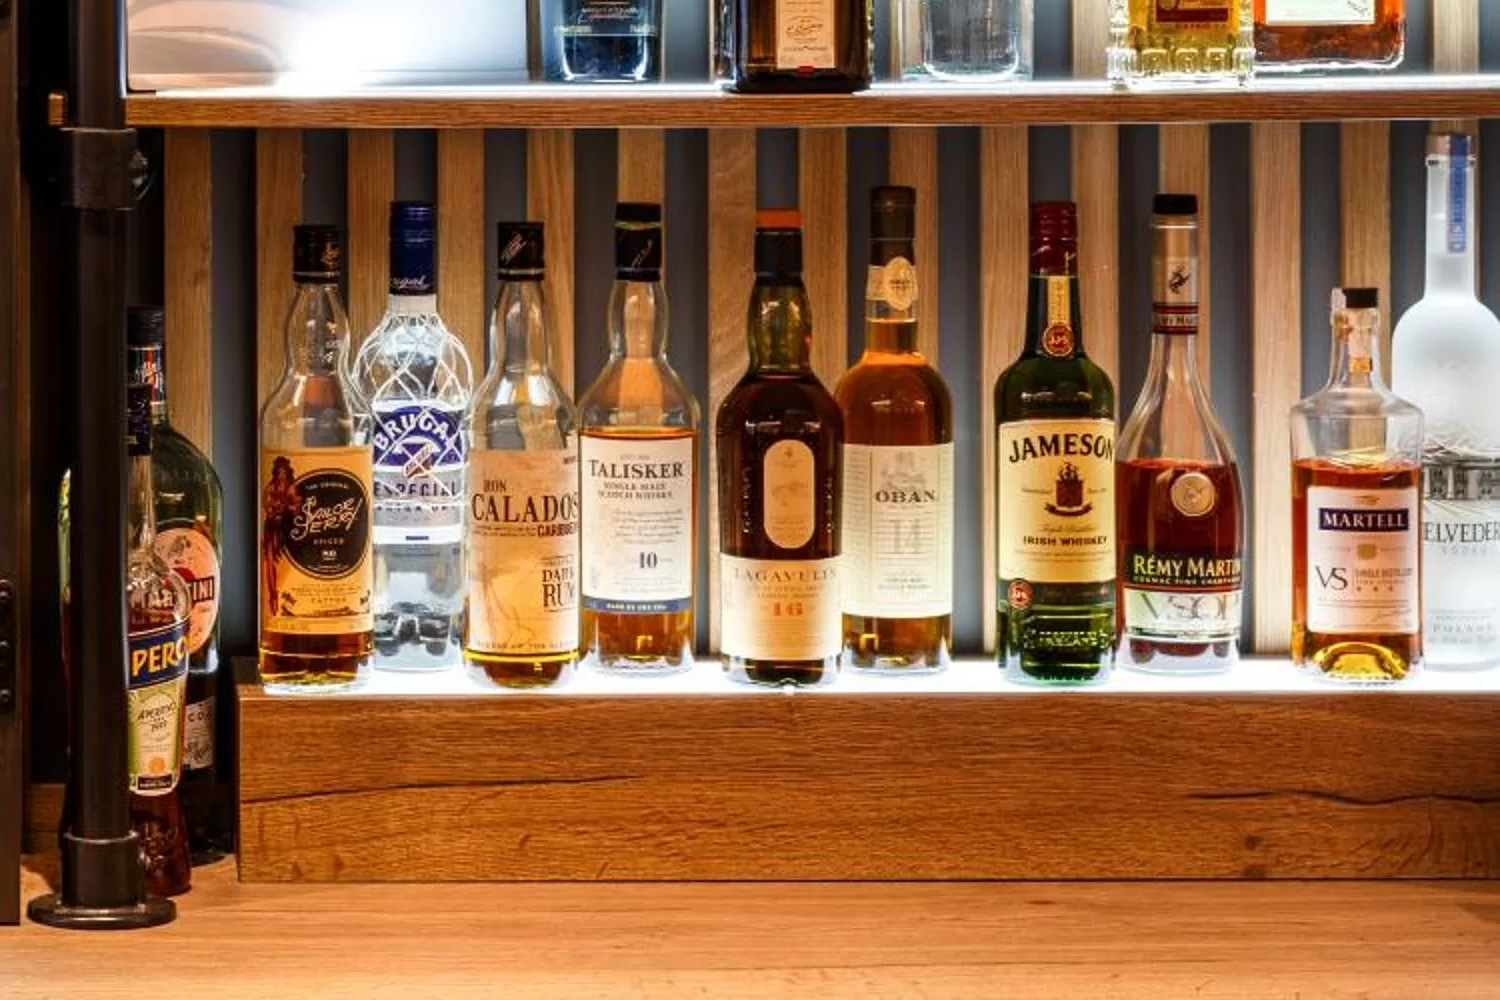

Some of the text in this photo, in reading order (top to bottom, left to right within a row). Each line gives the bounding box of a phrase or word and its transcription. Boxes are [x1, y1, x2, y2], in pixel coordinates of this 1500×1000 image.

[373, 413, 463, 451] BRUGA
[1009, 433, 1114, 463] JAMESON
[587, 458, 684, 479] TALISKER
[471, 492, 579, 523] CALADOS
[875, 488, 937, 503] OBAN
[1323, 511, 1407, 529] MARTELL
[1424, 520, 1500, 543] ELVEDER
[1023, 535, 1108, 545] IRISH WHISKEY
[639, 551, 658, 569] 10
[1133, 553, 1183, 577] RÉMY
[1315, 565, 1348, 591] VS
[130, 577, 215, 609] MARINI
[132, 636, 189, 677] PERO
